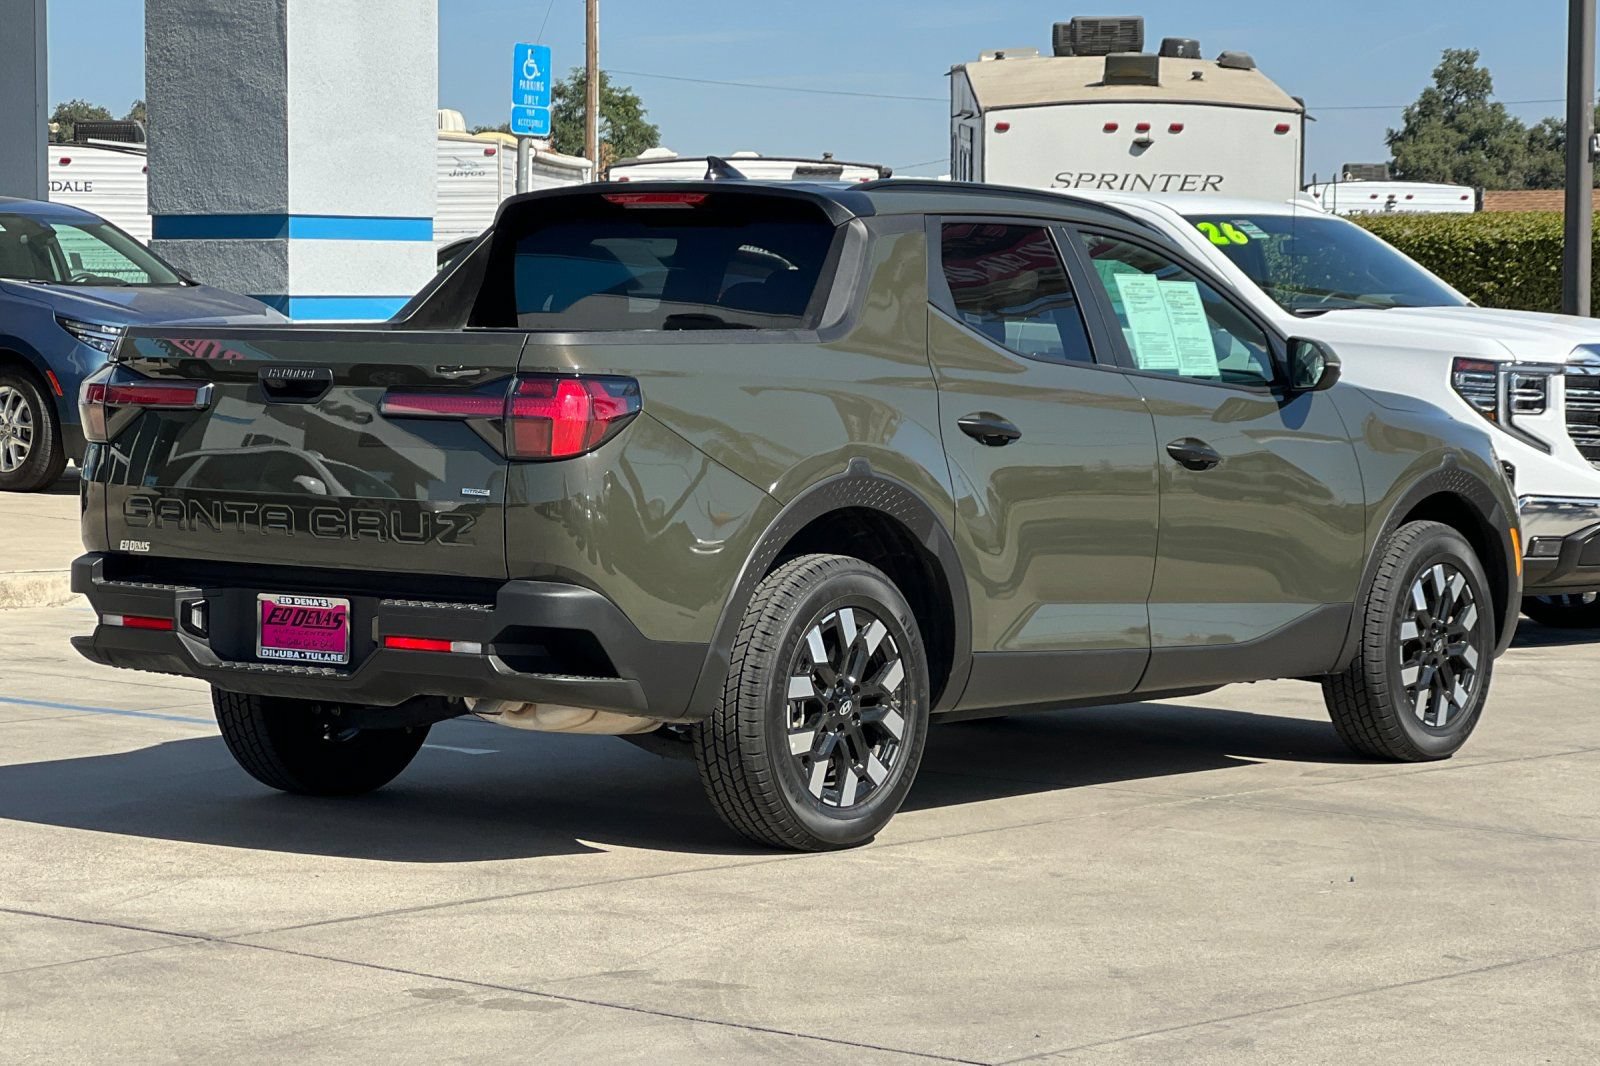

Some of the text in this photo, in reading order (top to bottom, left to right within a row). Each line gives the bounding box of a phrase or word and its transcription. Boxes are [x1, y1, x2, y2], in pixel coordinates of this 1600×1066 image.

[519, 80, 545, 92] PARKING
[523, 94, 539, 105] ONLY
[1050, 171, 1225, 193] SPRINTER
[1196, 222, 1249, 245] 26
[123, 496, 477, 547] SANTA CRUZ
[294, 598, 327, 606] DENA'S
[265, 607, 294, 626] ED
[305, 652, 343, 661] TULARE
